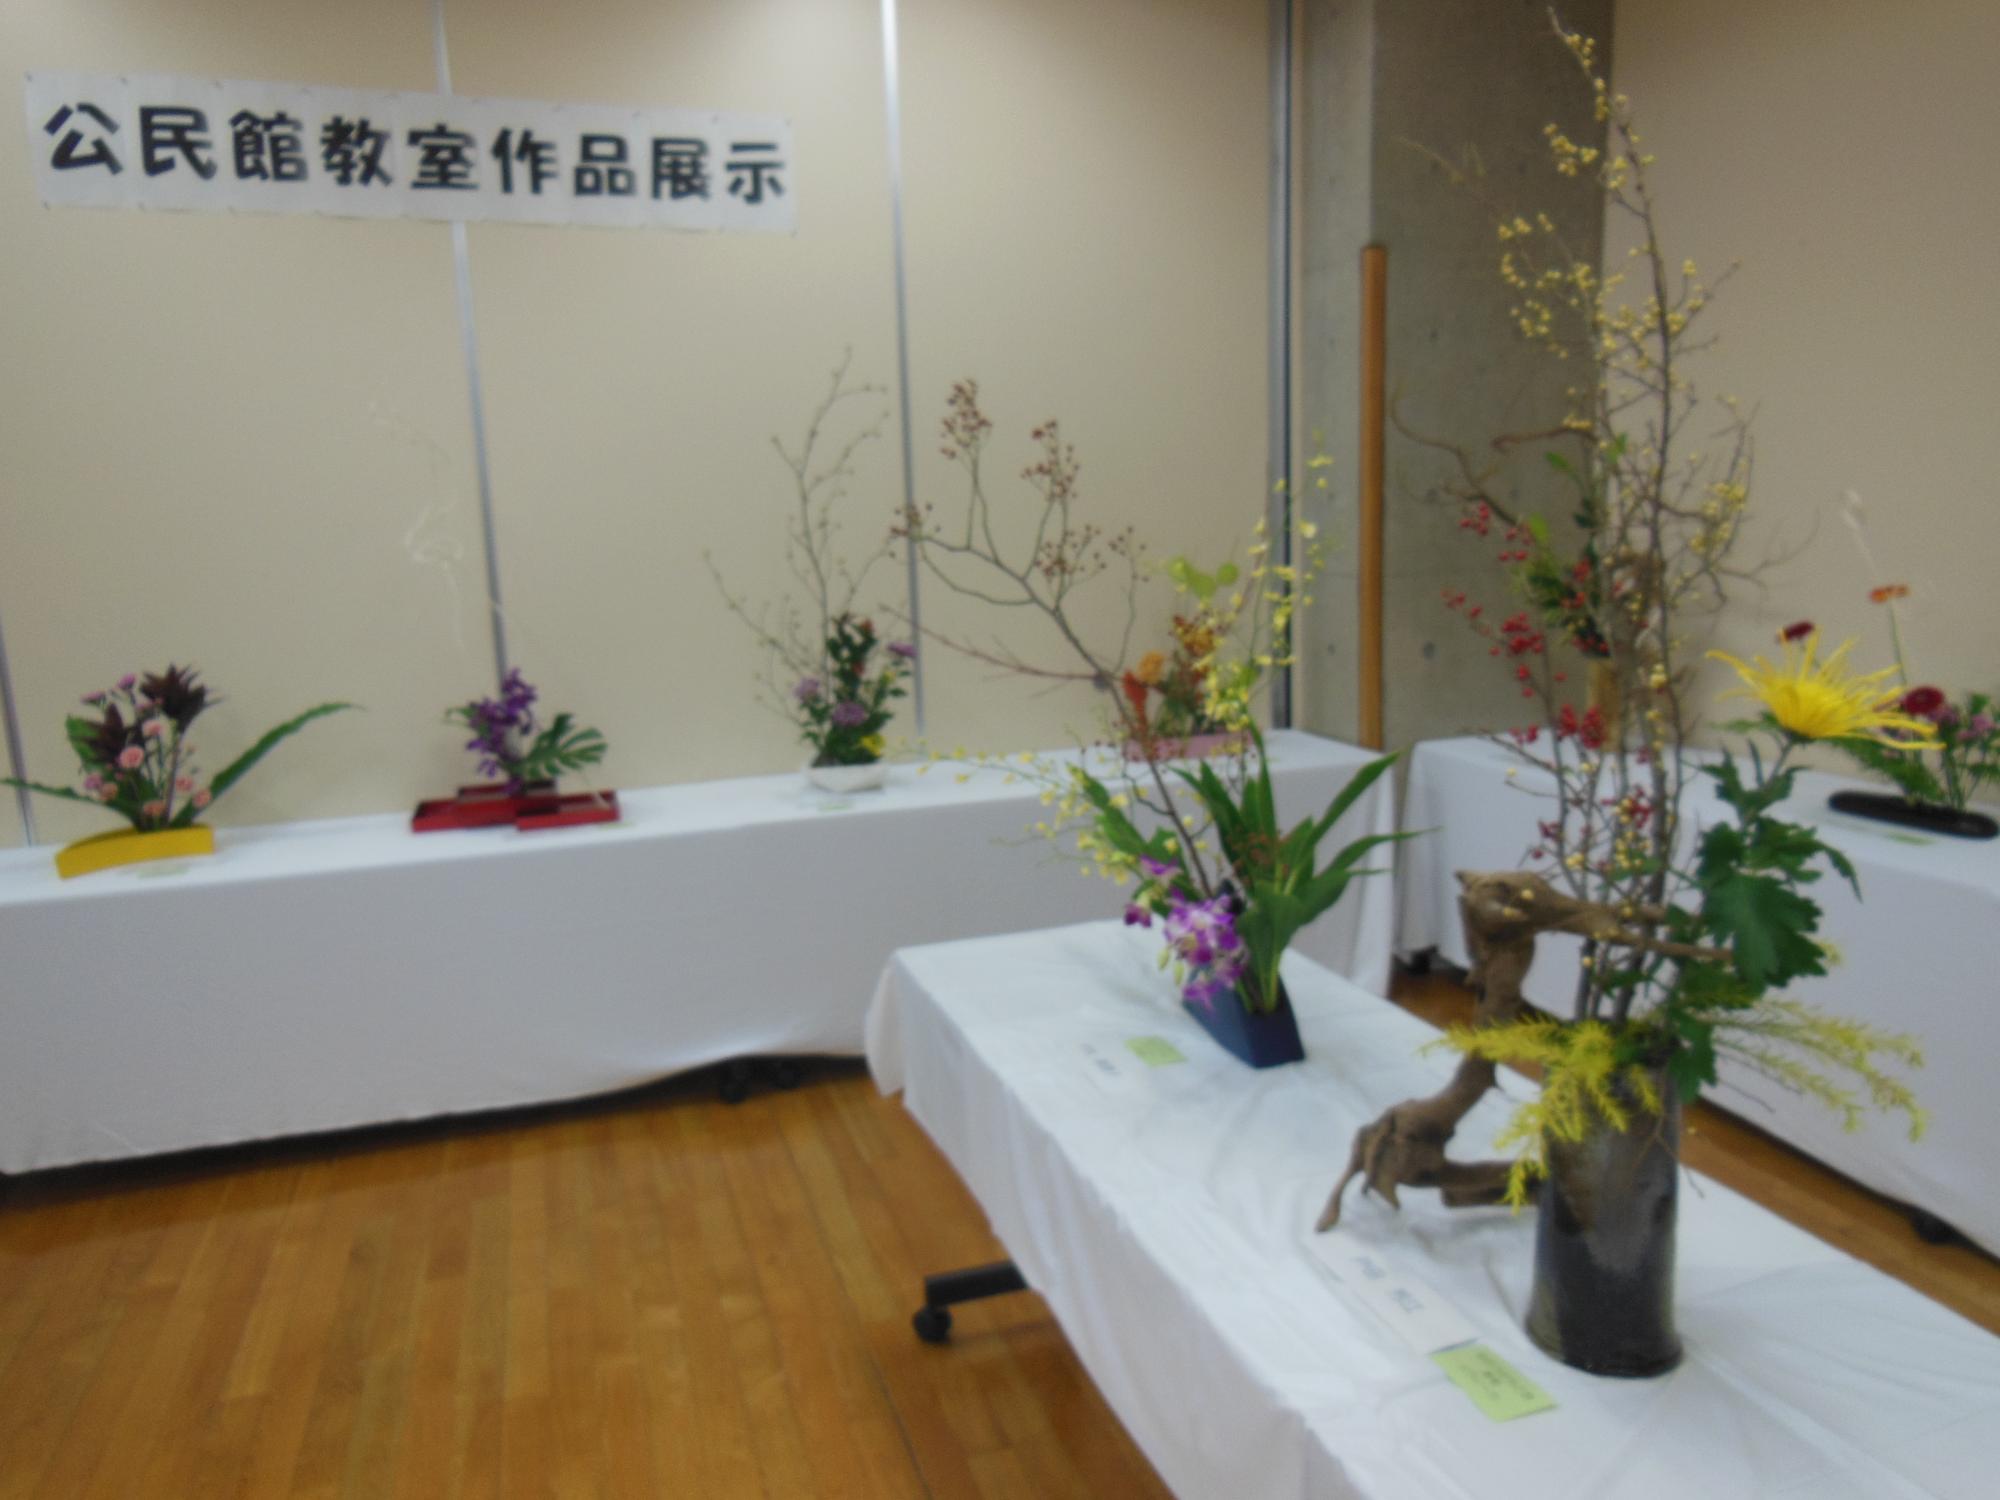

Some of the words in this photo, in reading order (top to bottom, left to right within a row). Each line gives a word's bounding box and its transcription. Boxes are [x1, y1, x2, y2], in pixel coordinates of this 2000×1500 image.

[43, 102, 787, 204] 公民館教室作品展示
